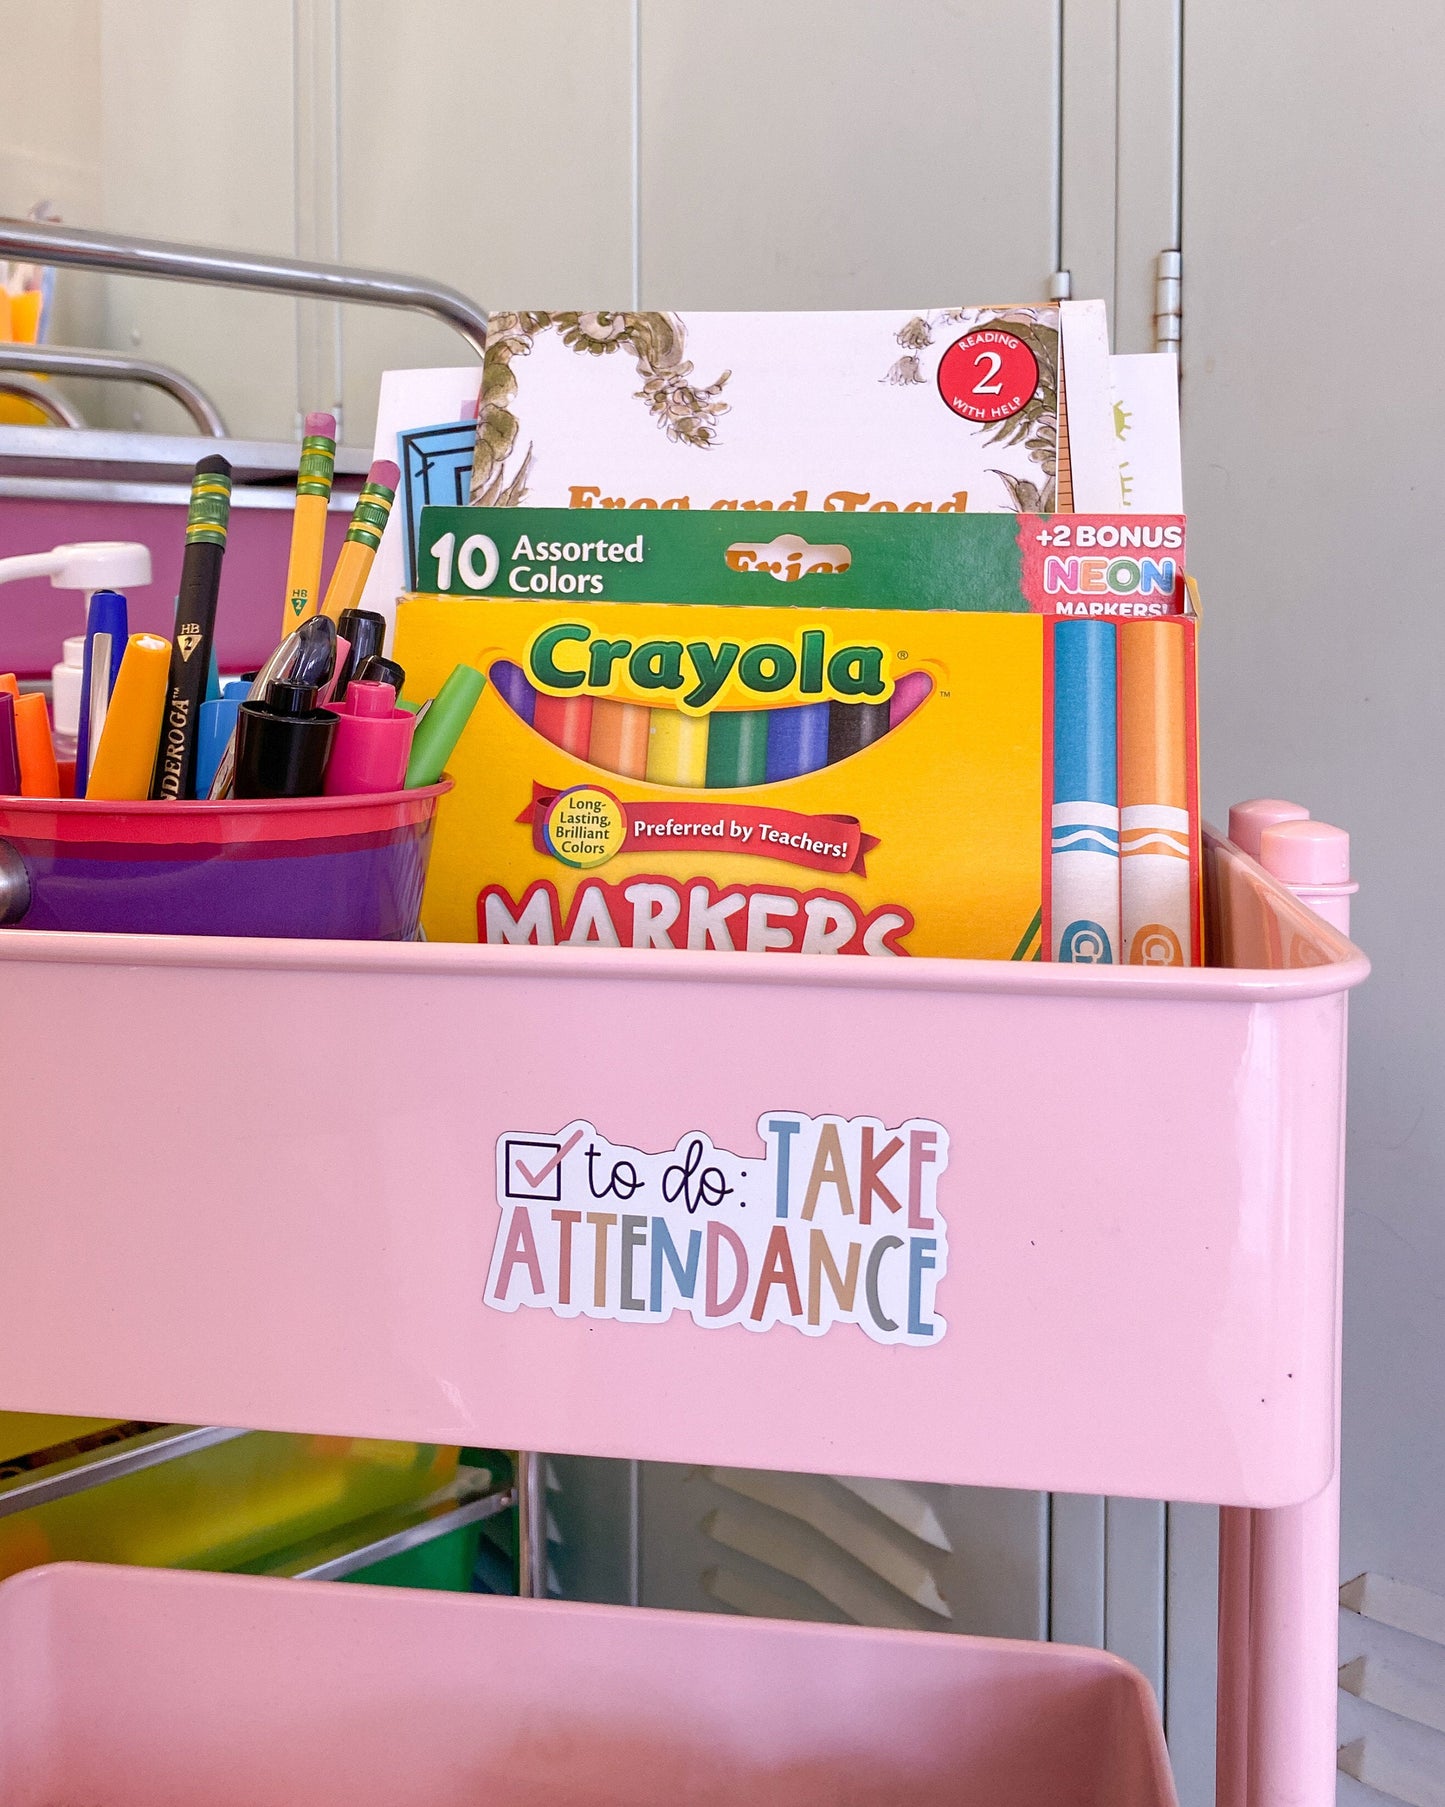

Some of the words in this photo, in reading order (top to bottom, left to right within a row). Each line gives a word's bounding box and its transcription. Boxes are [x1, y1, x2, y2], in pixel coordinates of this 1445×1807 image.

[958, 333, 1019, 351] READING
[971, 351, 1003, 395] 2
[952, 396, 986, 418] WITH
[991, 396, 1021, 418] HELP
[511, 534, 645, 563] Assorted
[1036, 525, 1071, 547] +2
[1076, 525, 1182, 549] BONUS
[430, 532, 500, 591] 10
[508, 565, 604, 594] Colors
[1044, 556, 1176, 596] NEON
[292, 589, 308, 598] HB
[181, 623, 200, 635] HB
[184, 637, 194, 651] 2
[568, 797, 607, 812] Long-
[560, 811, 611, 828] Lasting,
[555, 826, 610, 840] Brilliant
[634, 819, 724, 837] Preferred
[730, 820, 753, 842] by
[758, 824, 849, 859] Teachers!
[561, 841, 605, 855] Colors
[584, 1143, 645, 1200] to
[662, 1140, 748, 1214] do:
[768, 1119, 938, 1230] TAKE
[493, 1206, 937, 1337] ATTENDANCE
